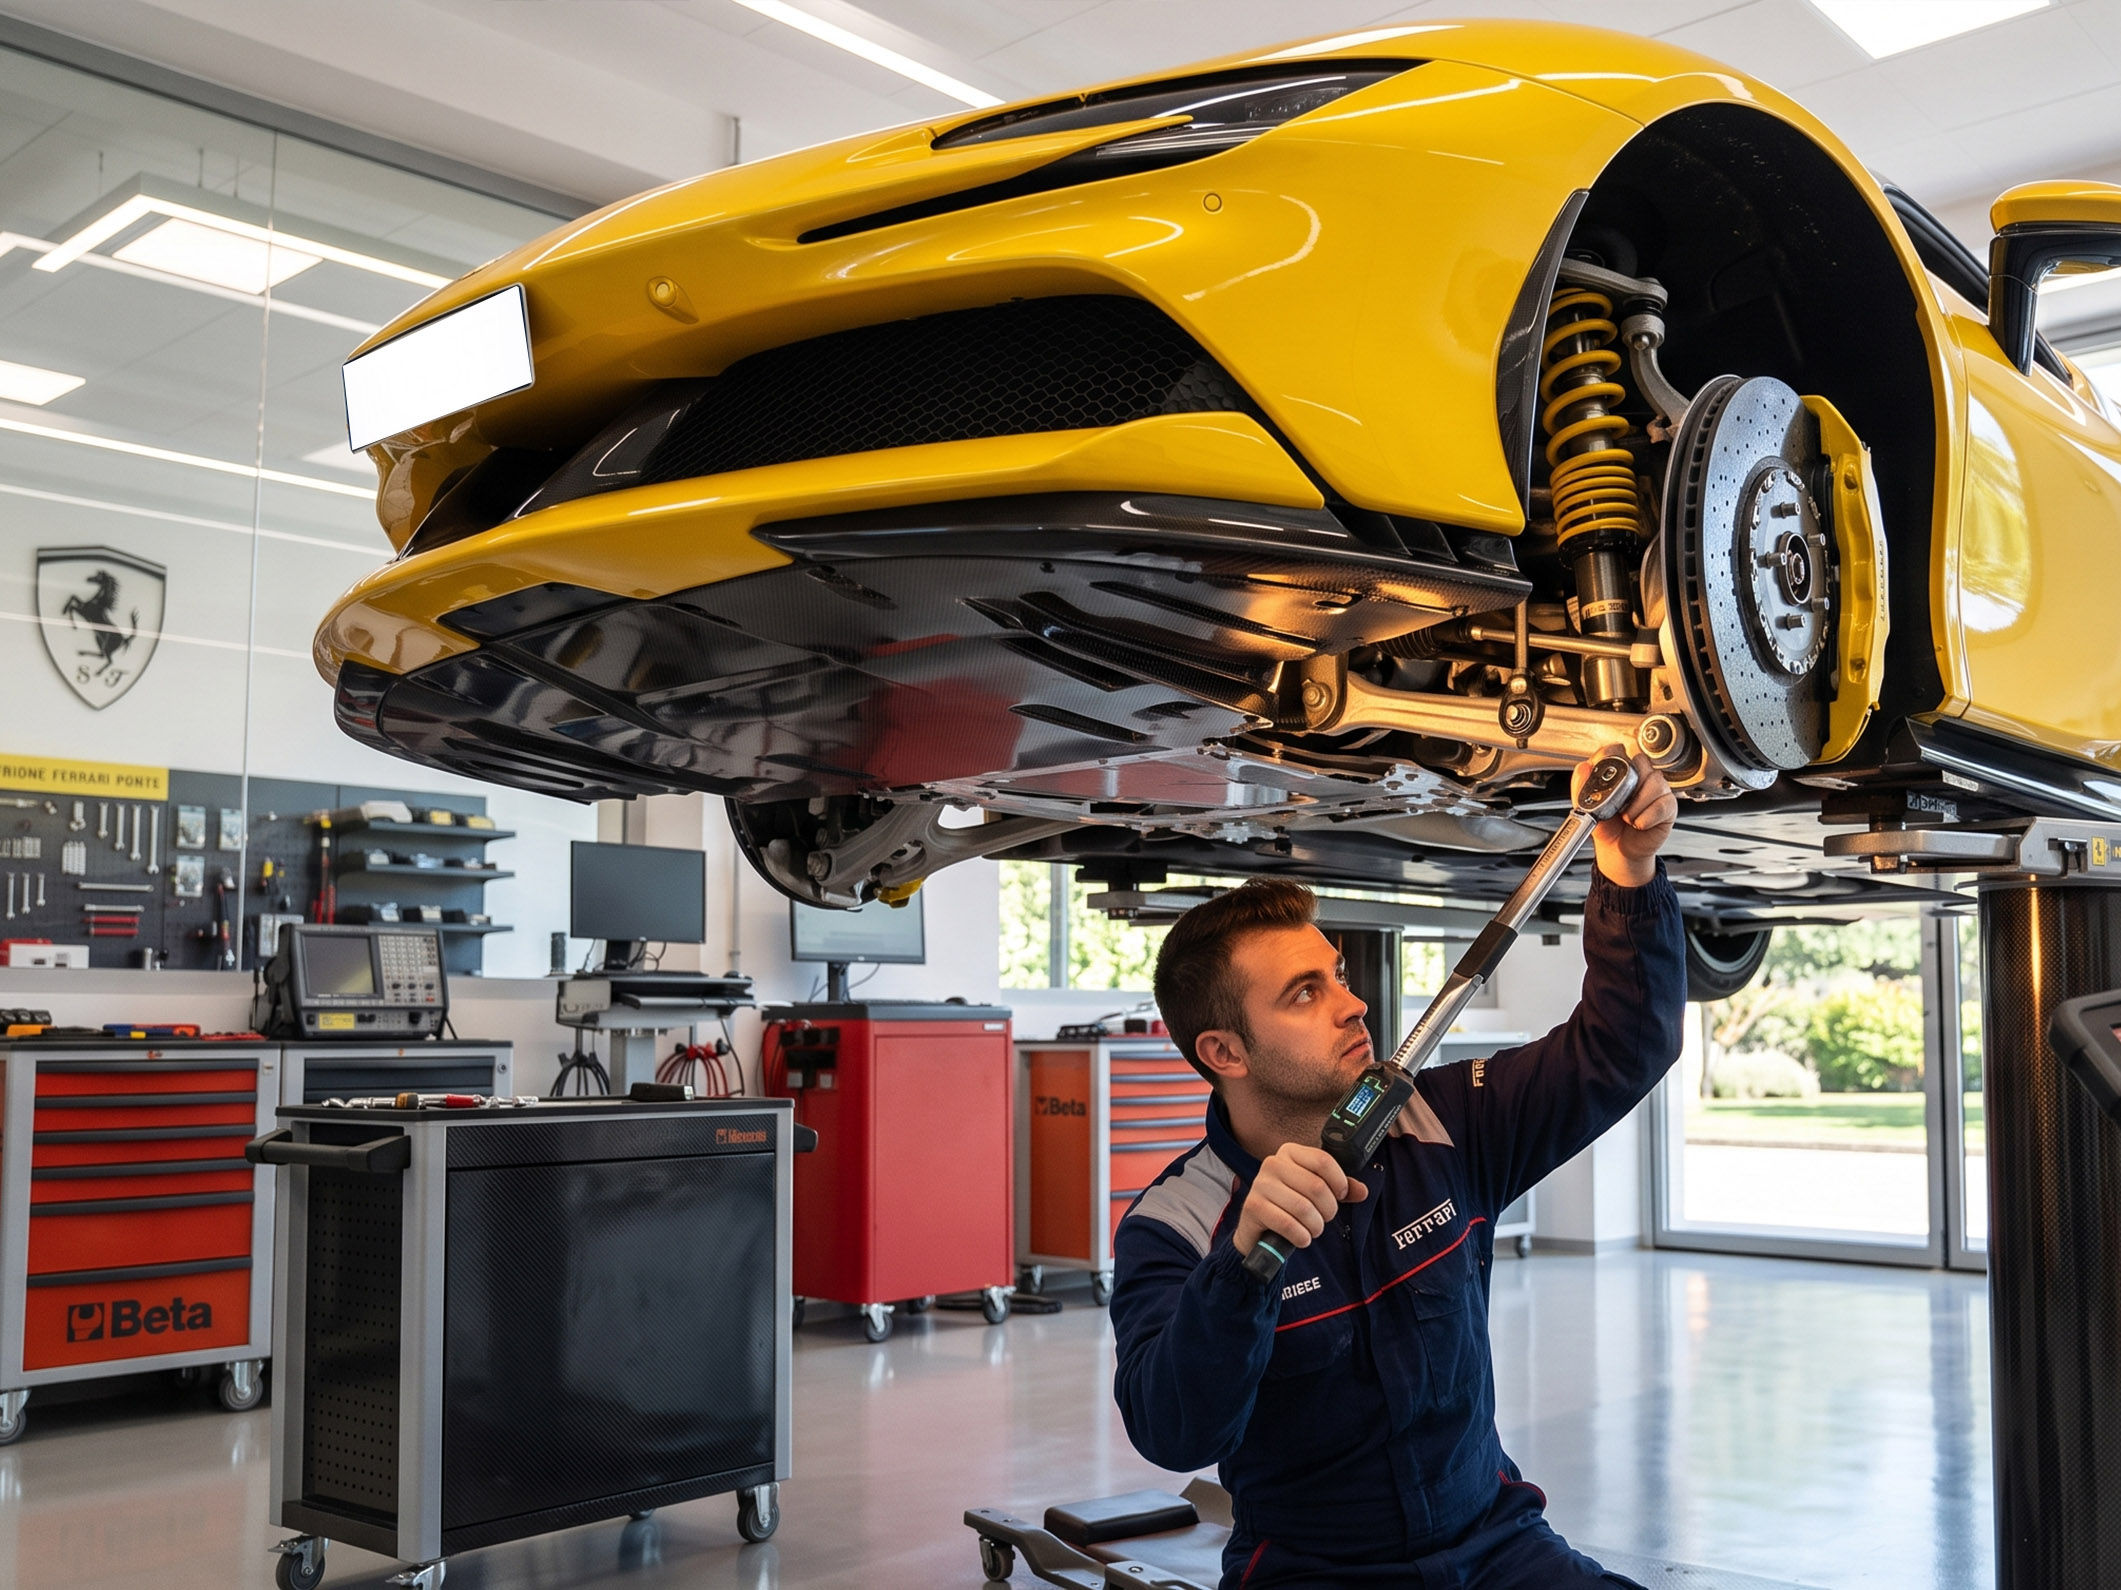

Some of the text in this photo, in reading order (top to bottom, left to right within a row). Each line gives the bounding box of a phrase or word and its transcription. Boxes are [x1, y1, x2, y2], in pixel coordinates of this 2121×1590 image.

[0, 765, 160, 789] RIONE FERRARI PONTE
[1049, 1096, 1087, 1116] Beta
[111, 1297, 212, 1338] Beta
